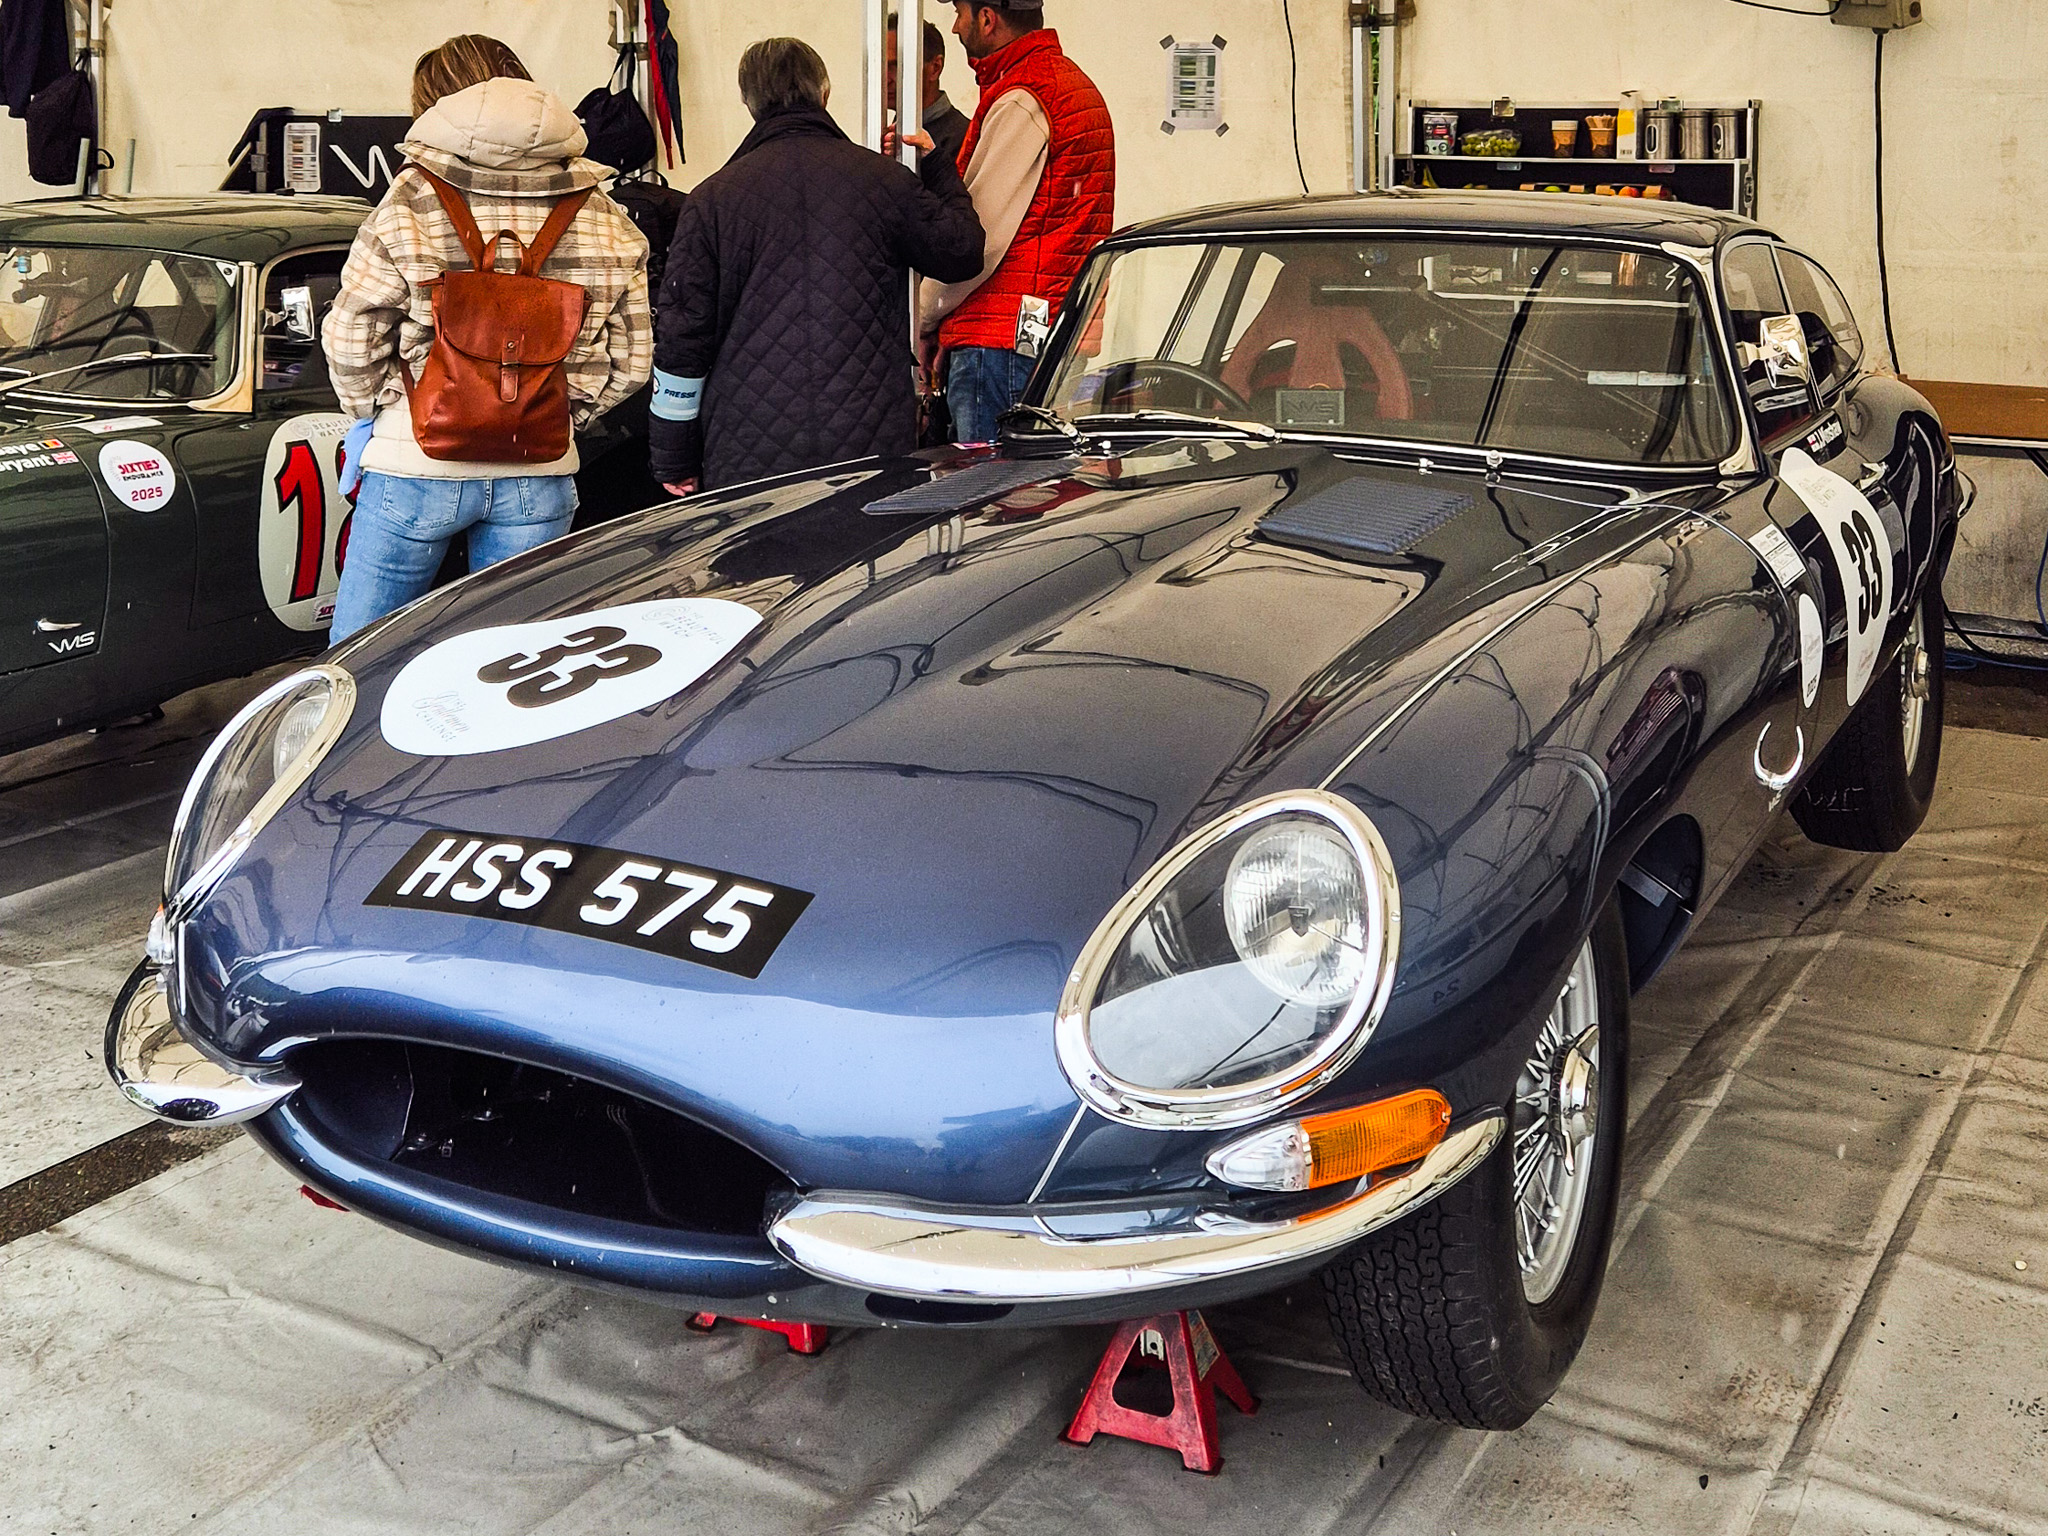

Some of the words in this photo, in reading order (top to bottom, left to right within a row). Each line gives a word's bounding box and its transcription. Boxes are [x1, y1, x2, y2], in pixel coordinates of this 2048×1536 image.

[664, 388, 698, 399] PRESSE
[118, 459, 160, 475] SIXTIES
[122, 470, 164, 481] ENDURANCE
[131, 486, 163, 501] 2025
[1840, 509, 1883, 635] 33
[476, 625, 663, 708] 33
[396, 837, 573, 910] HSS
[578, 860, 775, 955] 575
